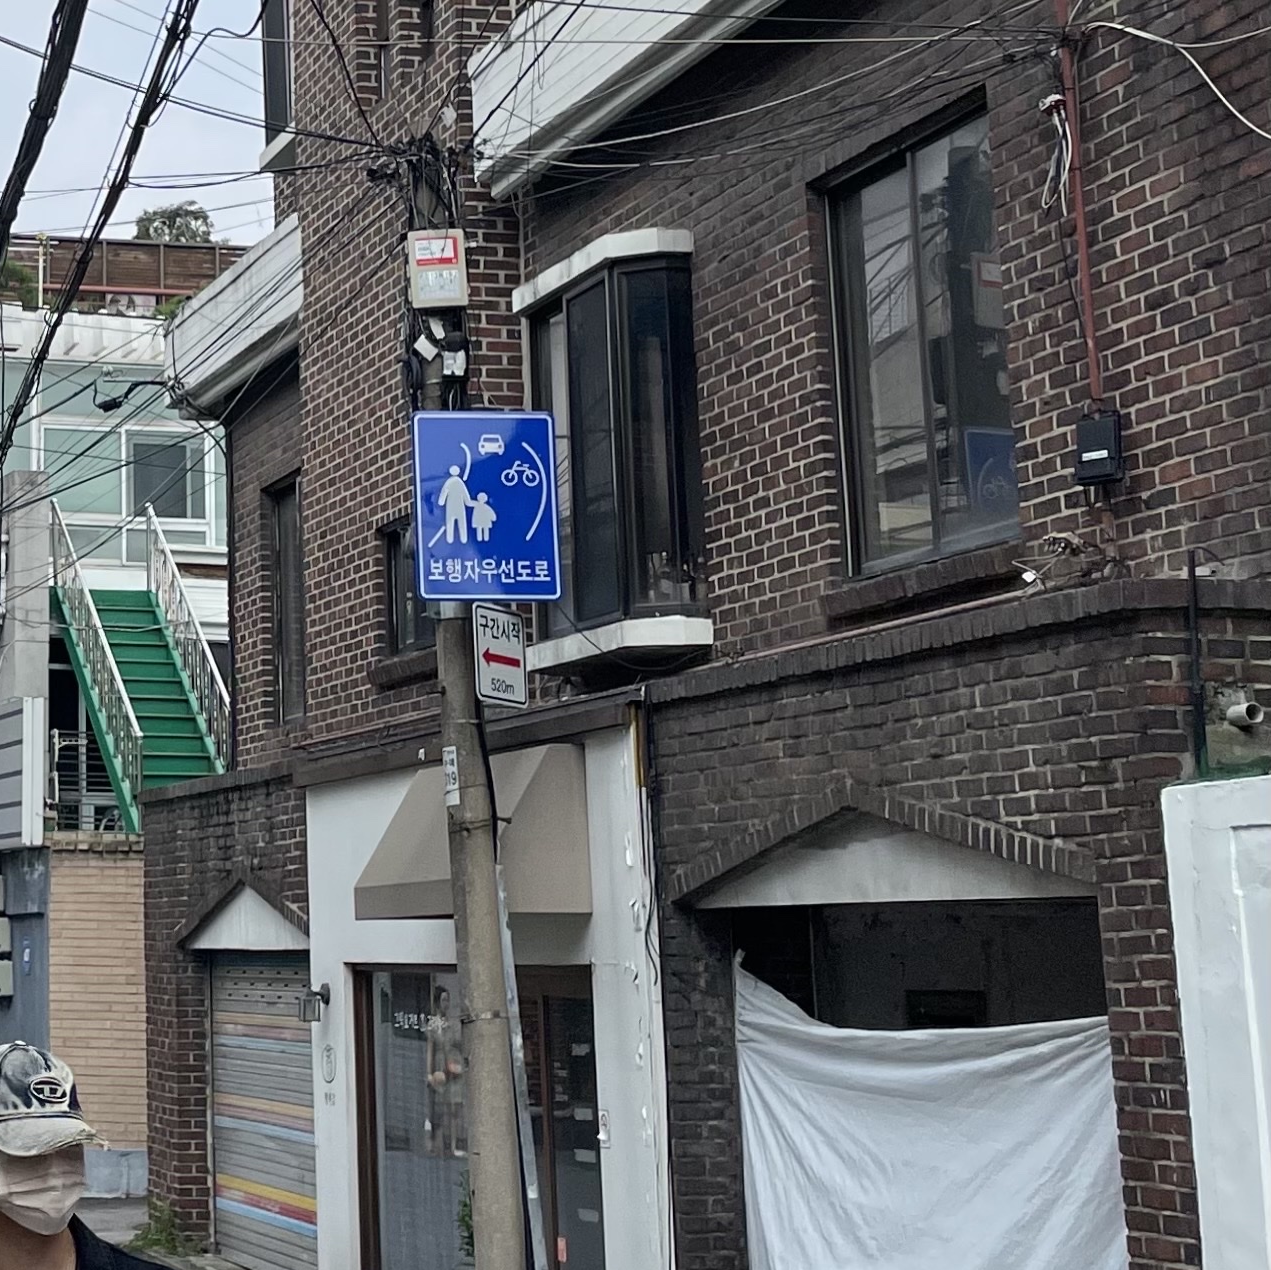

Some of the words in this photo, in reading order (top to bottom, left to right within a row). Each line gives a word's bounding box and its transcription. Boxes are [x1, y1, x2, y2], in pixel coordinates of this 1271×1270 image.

[428, 558, 552, 584] 보행자우선도로
[478, 613, 522, 645] 구간시작
[490, 677, 516, 696] 520m
